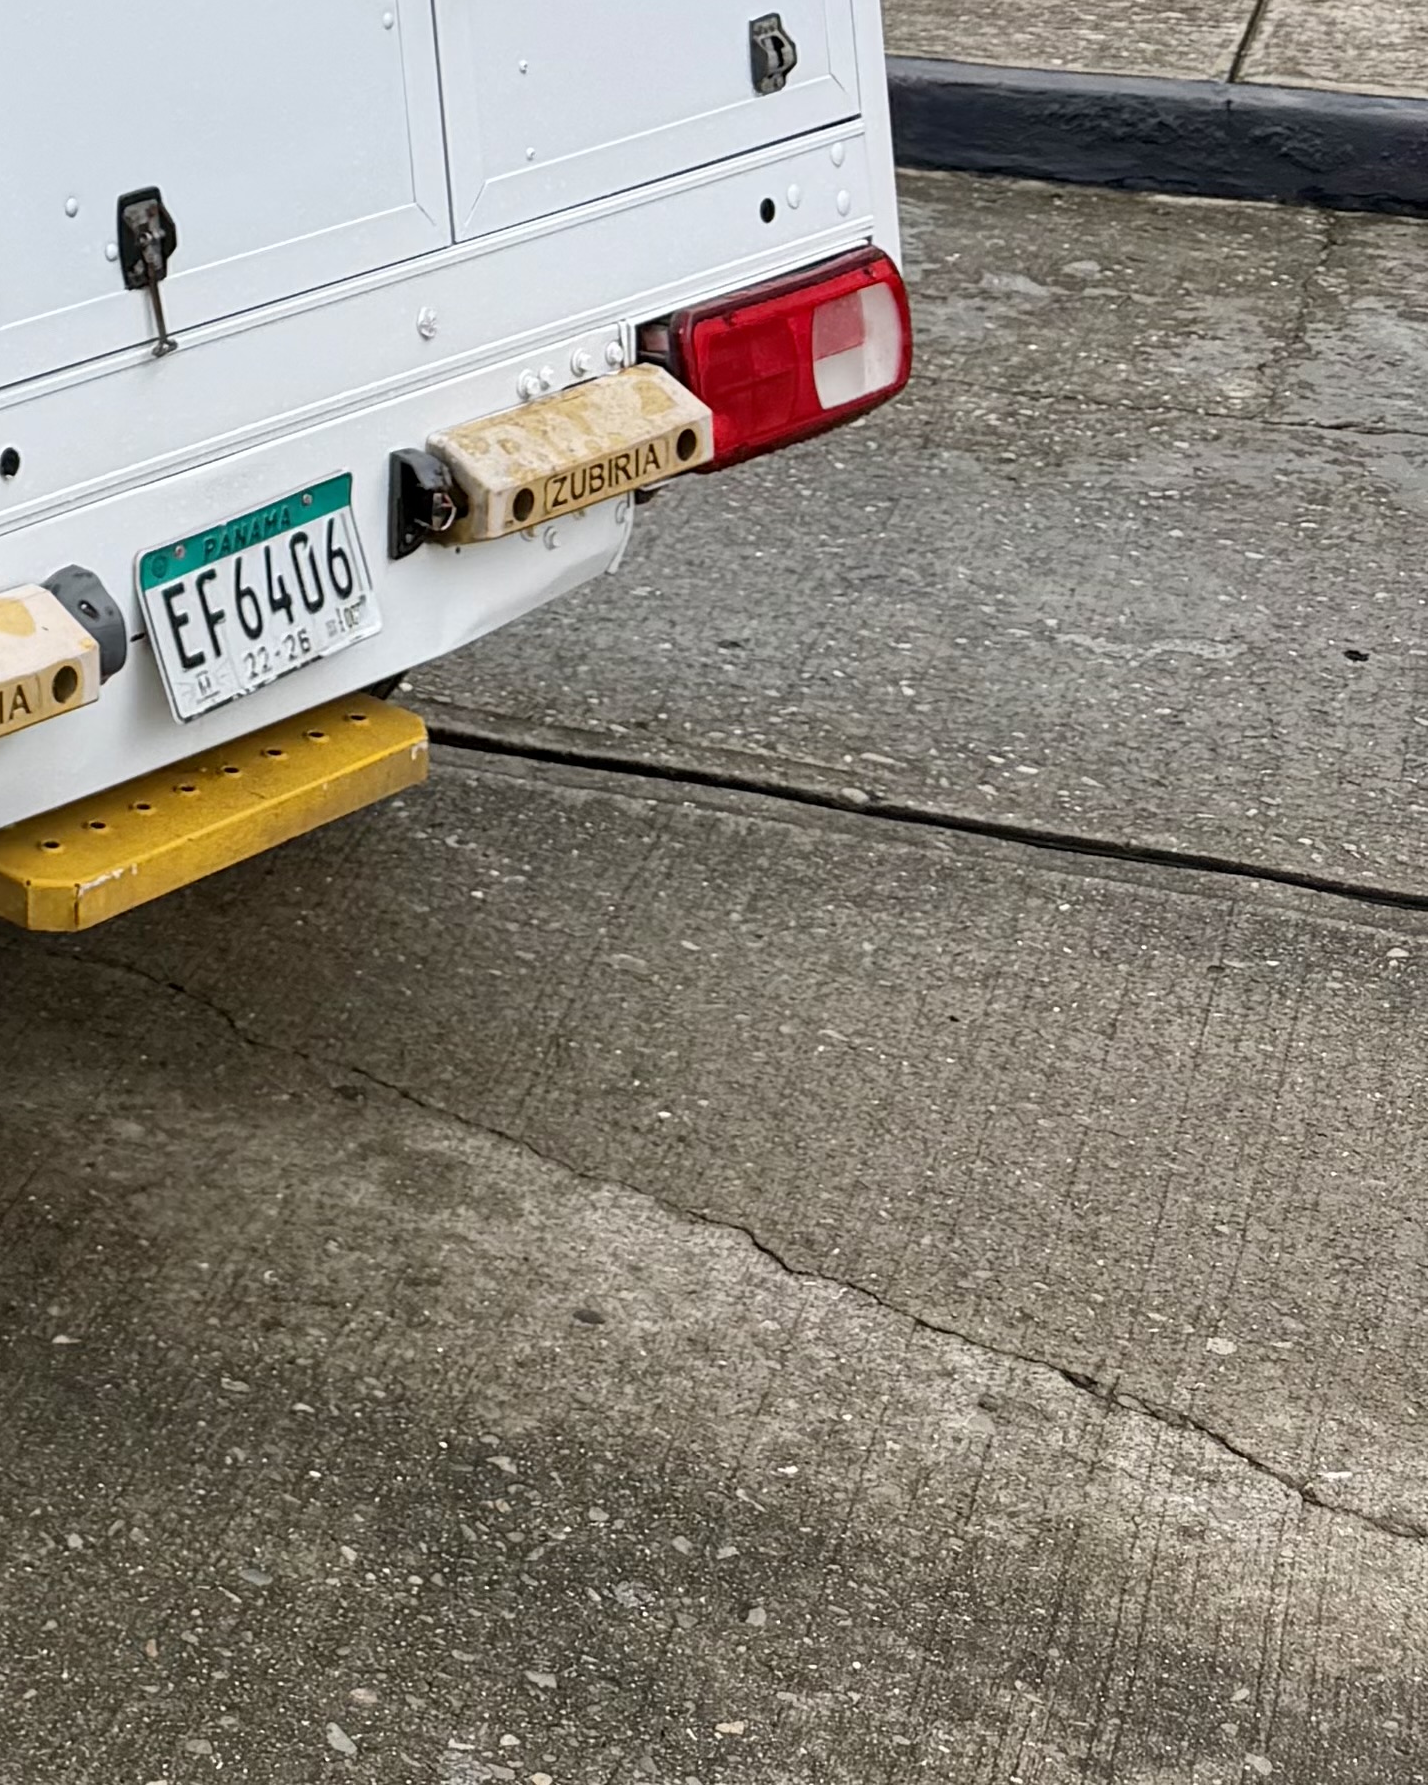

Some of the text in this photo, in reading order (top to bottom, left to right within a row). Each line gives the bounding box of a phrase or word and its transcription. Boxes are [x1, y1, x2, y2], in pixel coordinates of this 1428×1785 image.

[551, 442, 662, 509] ZUBIRIA
[202, 504, 293, 563] PANAMA
[162, 516, 354, 671] EF6406
[243, 627, 312, 681] 22-26
